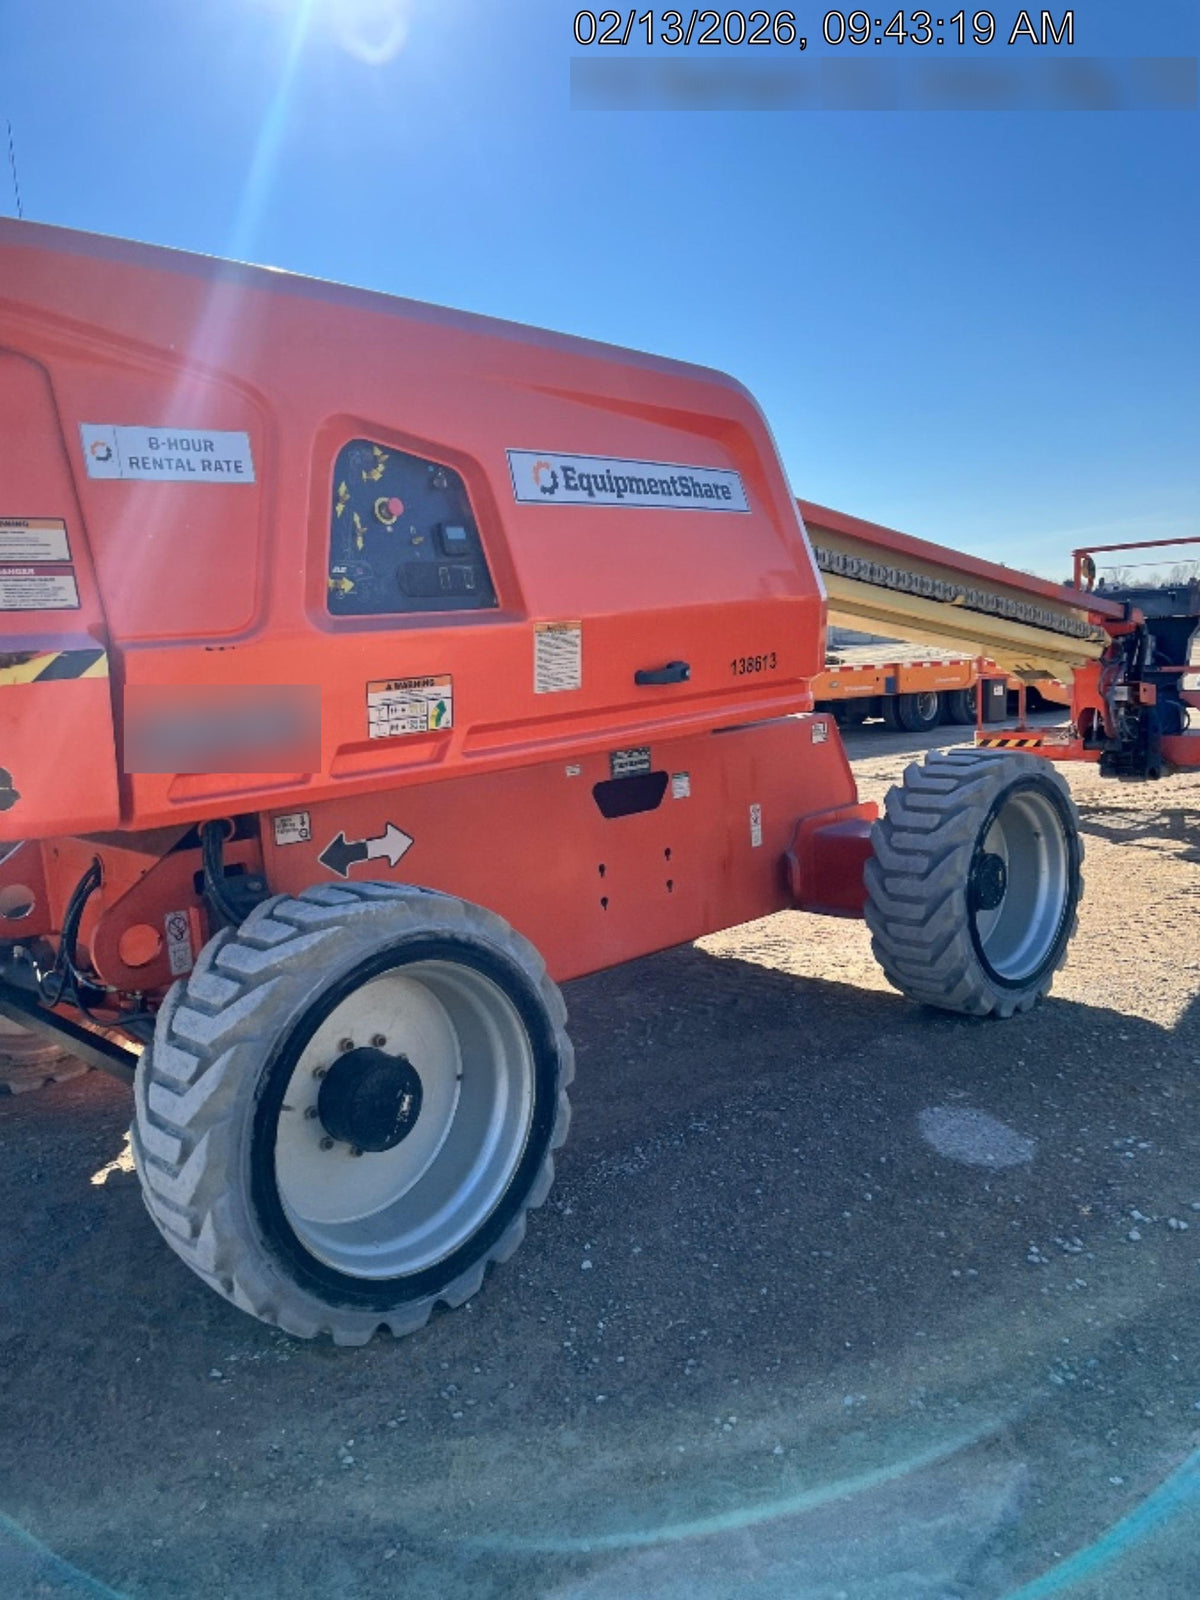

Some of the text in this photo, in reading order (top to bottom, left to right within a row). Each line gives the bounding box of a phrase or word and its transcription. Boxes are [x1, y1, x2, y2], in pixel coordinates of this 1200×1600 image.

[128, 456, 244, 474] RENTAL RATE
[560, 465, 732, 499] EquipmentShare
[731, 651, 777, 675] 138613
